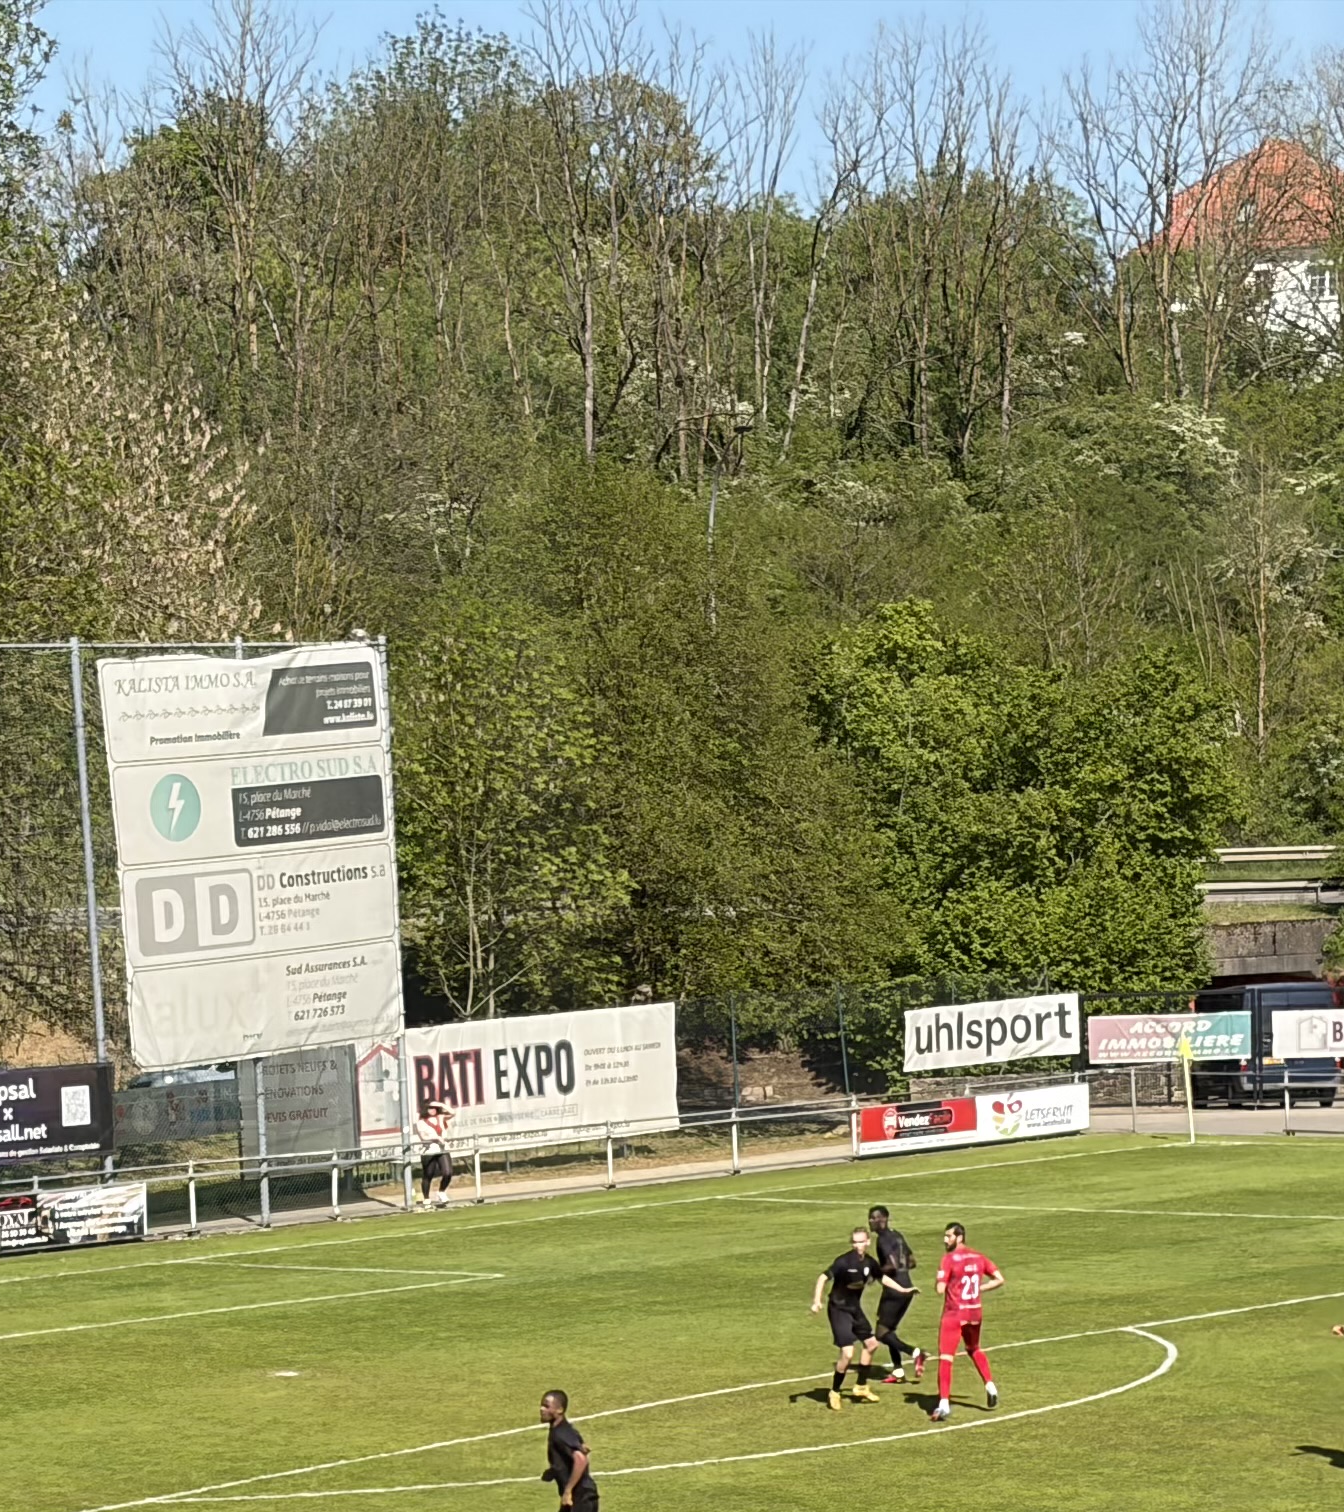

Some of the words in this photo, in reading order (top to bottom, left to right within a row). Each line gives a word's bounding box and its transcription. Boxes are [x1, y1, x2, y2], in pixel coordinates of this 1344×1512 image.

[114, 675, 180, 697] KALISTA
[185, 673, 230, 690] IMMO
[150, 733, 193, 746] Promotion
[194, 731, 240, 743] Immobilière
[231, 760, 312, 785] ELECTRO
[317, 757, 349, 779] SUD
[250, 789, 271, 806] place
[272, 790, 282, 801] du
[284, 787, 311, 800] Marché
[265, 806, 302, 820] Pétange
[247, 827, 265, 839] 621
[266, 825, 283, 837] 286
[284, 823, 301, 835] 556
[257, 874, 275, 891] DD
[279, 865, 368, 888] Constructions
[272, 895, 292, 908] place
[293, 894, 303, 904] du
[304, 891, 331, 903] Marché
[259, 910, 286, 922] L-4756
[287, 907, 320, 920] Pétange
[286, 964, 303, 976] Sud
[304, 961, 351, 974] Assurances
[313, 991, 347, 1004] Pétange
[294, 1009, 310, 1021] 621
[312, 1007, 329, 1019] 726
[330, 1005, 346, 1016] 573
[915, 1003, 1073, 1057] uhlsport
[1129, 1020, 1212, 1034] ACCORD
[262, 1063, 296, 1076] ROJETS
[413, 1048, 485, 1112] BATI
[493, 1038, 576, 1100] EXPO
[264, 1085, 325, 1100] ENOVATIONS
[265, 1111, 287, 1123] EVIS
[288, 1107, 328, 1121] GRATUIT
[898, 1113, 930, 1128] Vendez
[1025, 1104, 1074, 1121] LETSFRUIT
